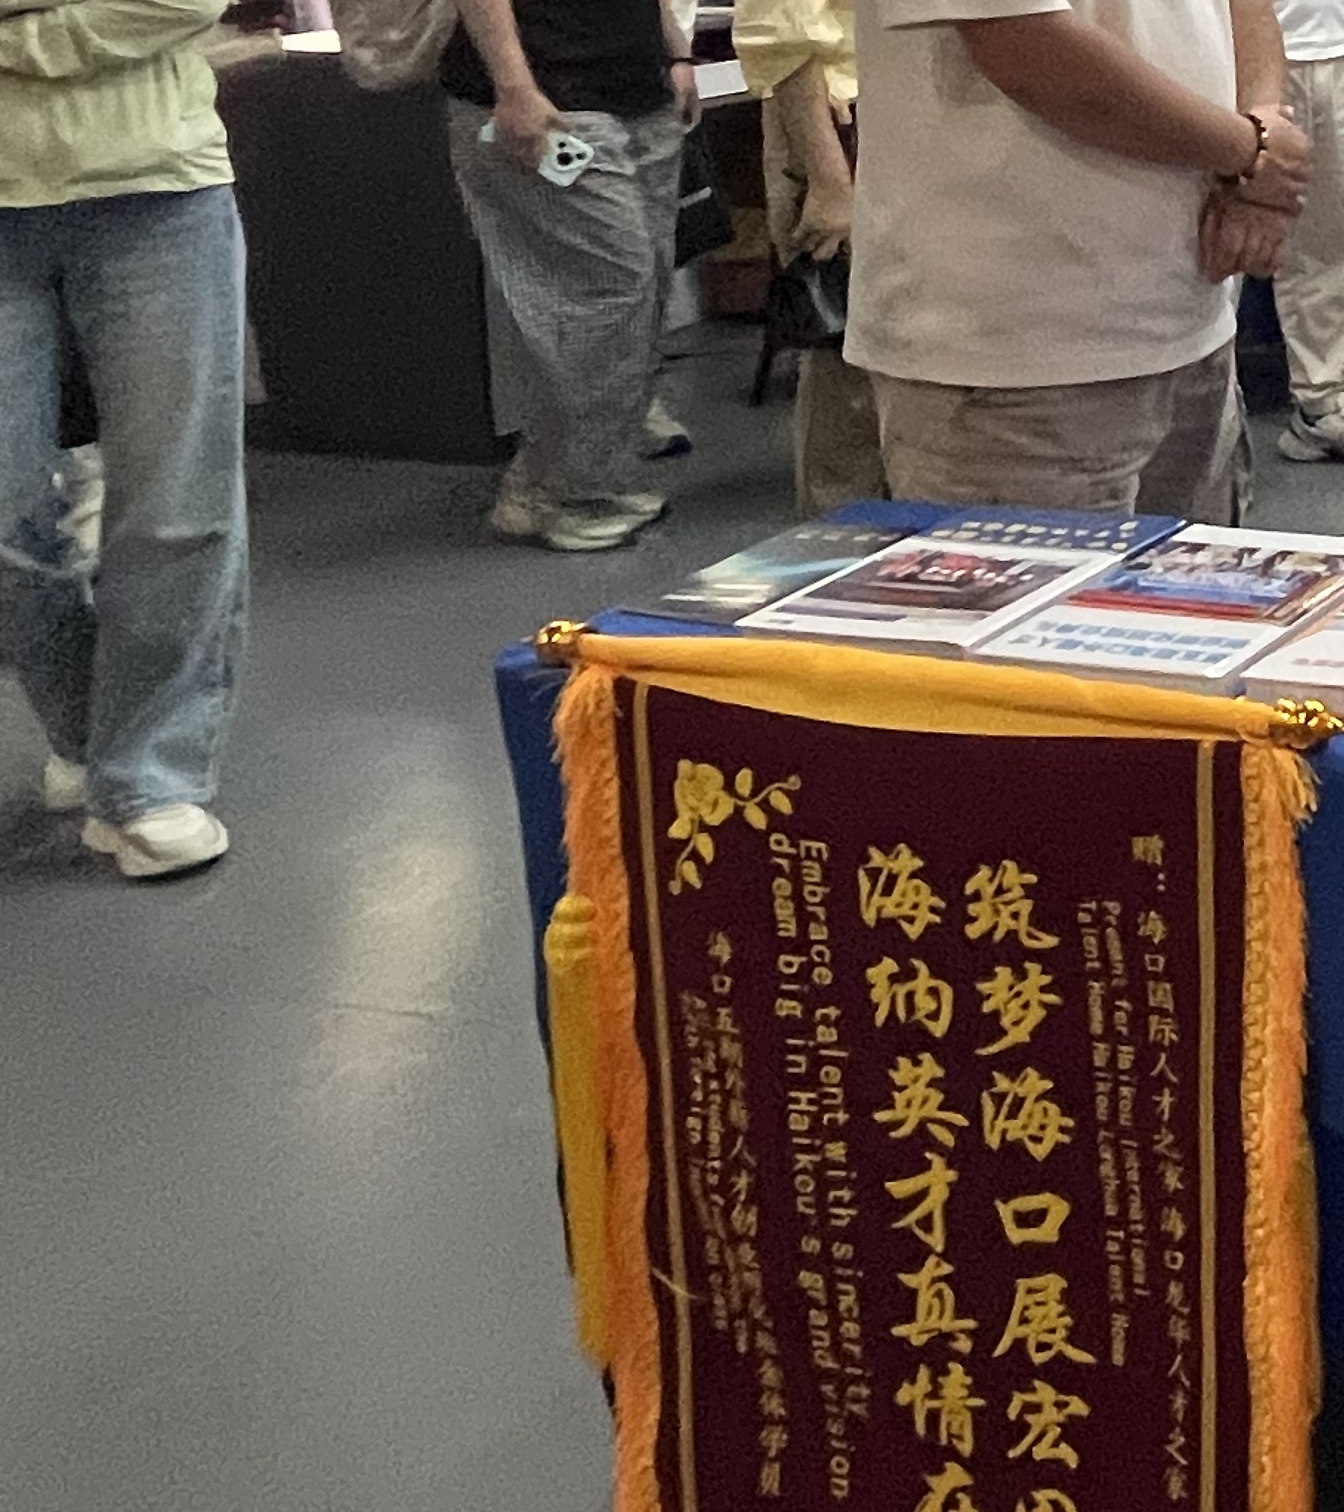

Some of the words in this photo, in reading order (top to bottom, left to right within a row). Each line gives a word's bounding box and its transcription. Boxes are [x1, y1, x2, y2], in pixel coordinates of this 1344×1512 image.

[768, 832, 798, 937] dream
[800, 839, 834, 986] Embrace
[774, 953, 809, 1018] big
[786, 1038, 816, 1074] in
[813, 1005, 850, 1126] talent
[1077, 900, 1101, 969] Talent
[1105, 1229, 1127, 1303] Talent
[823, 1140, 859, 1227] with
[798, 1269, 840, 1369] grand
[831, 1241, 872, 1420] sincerity
[821, 1384, 857, 1499] vision
